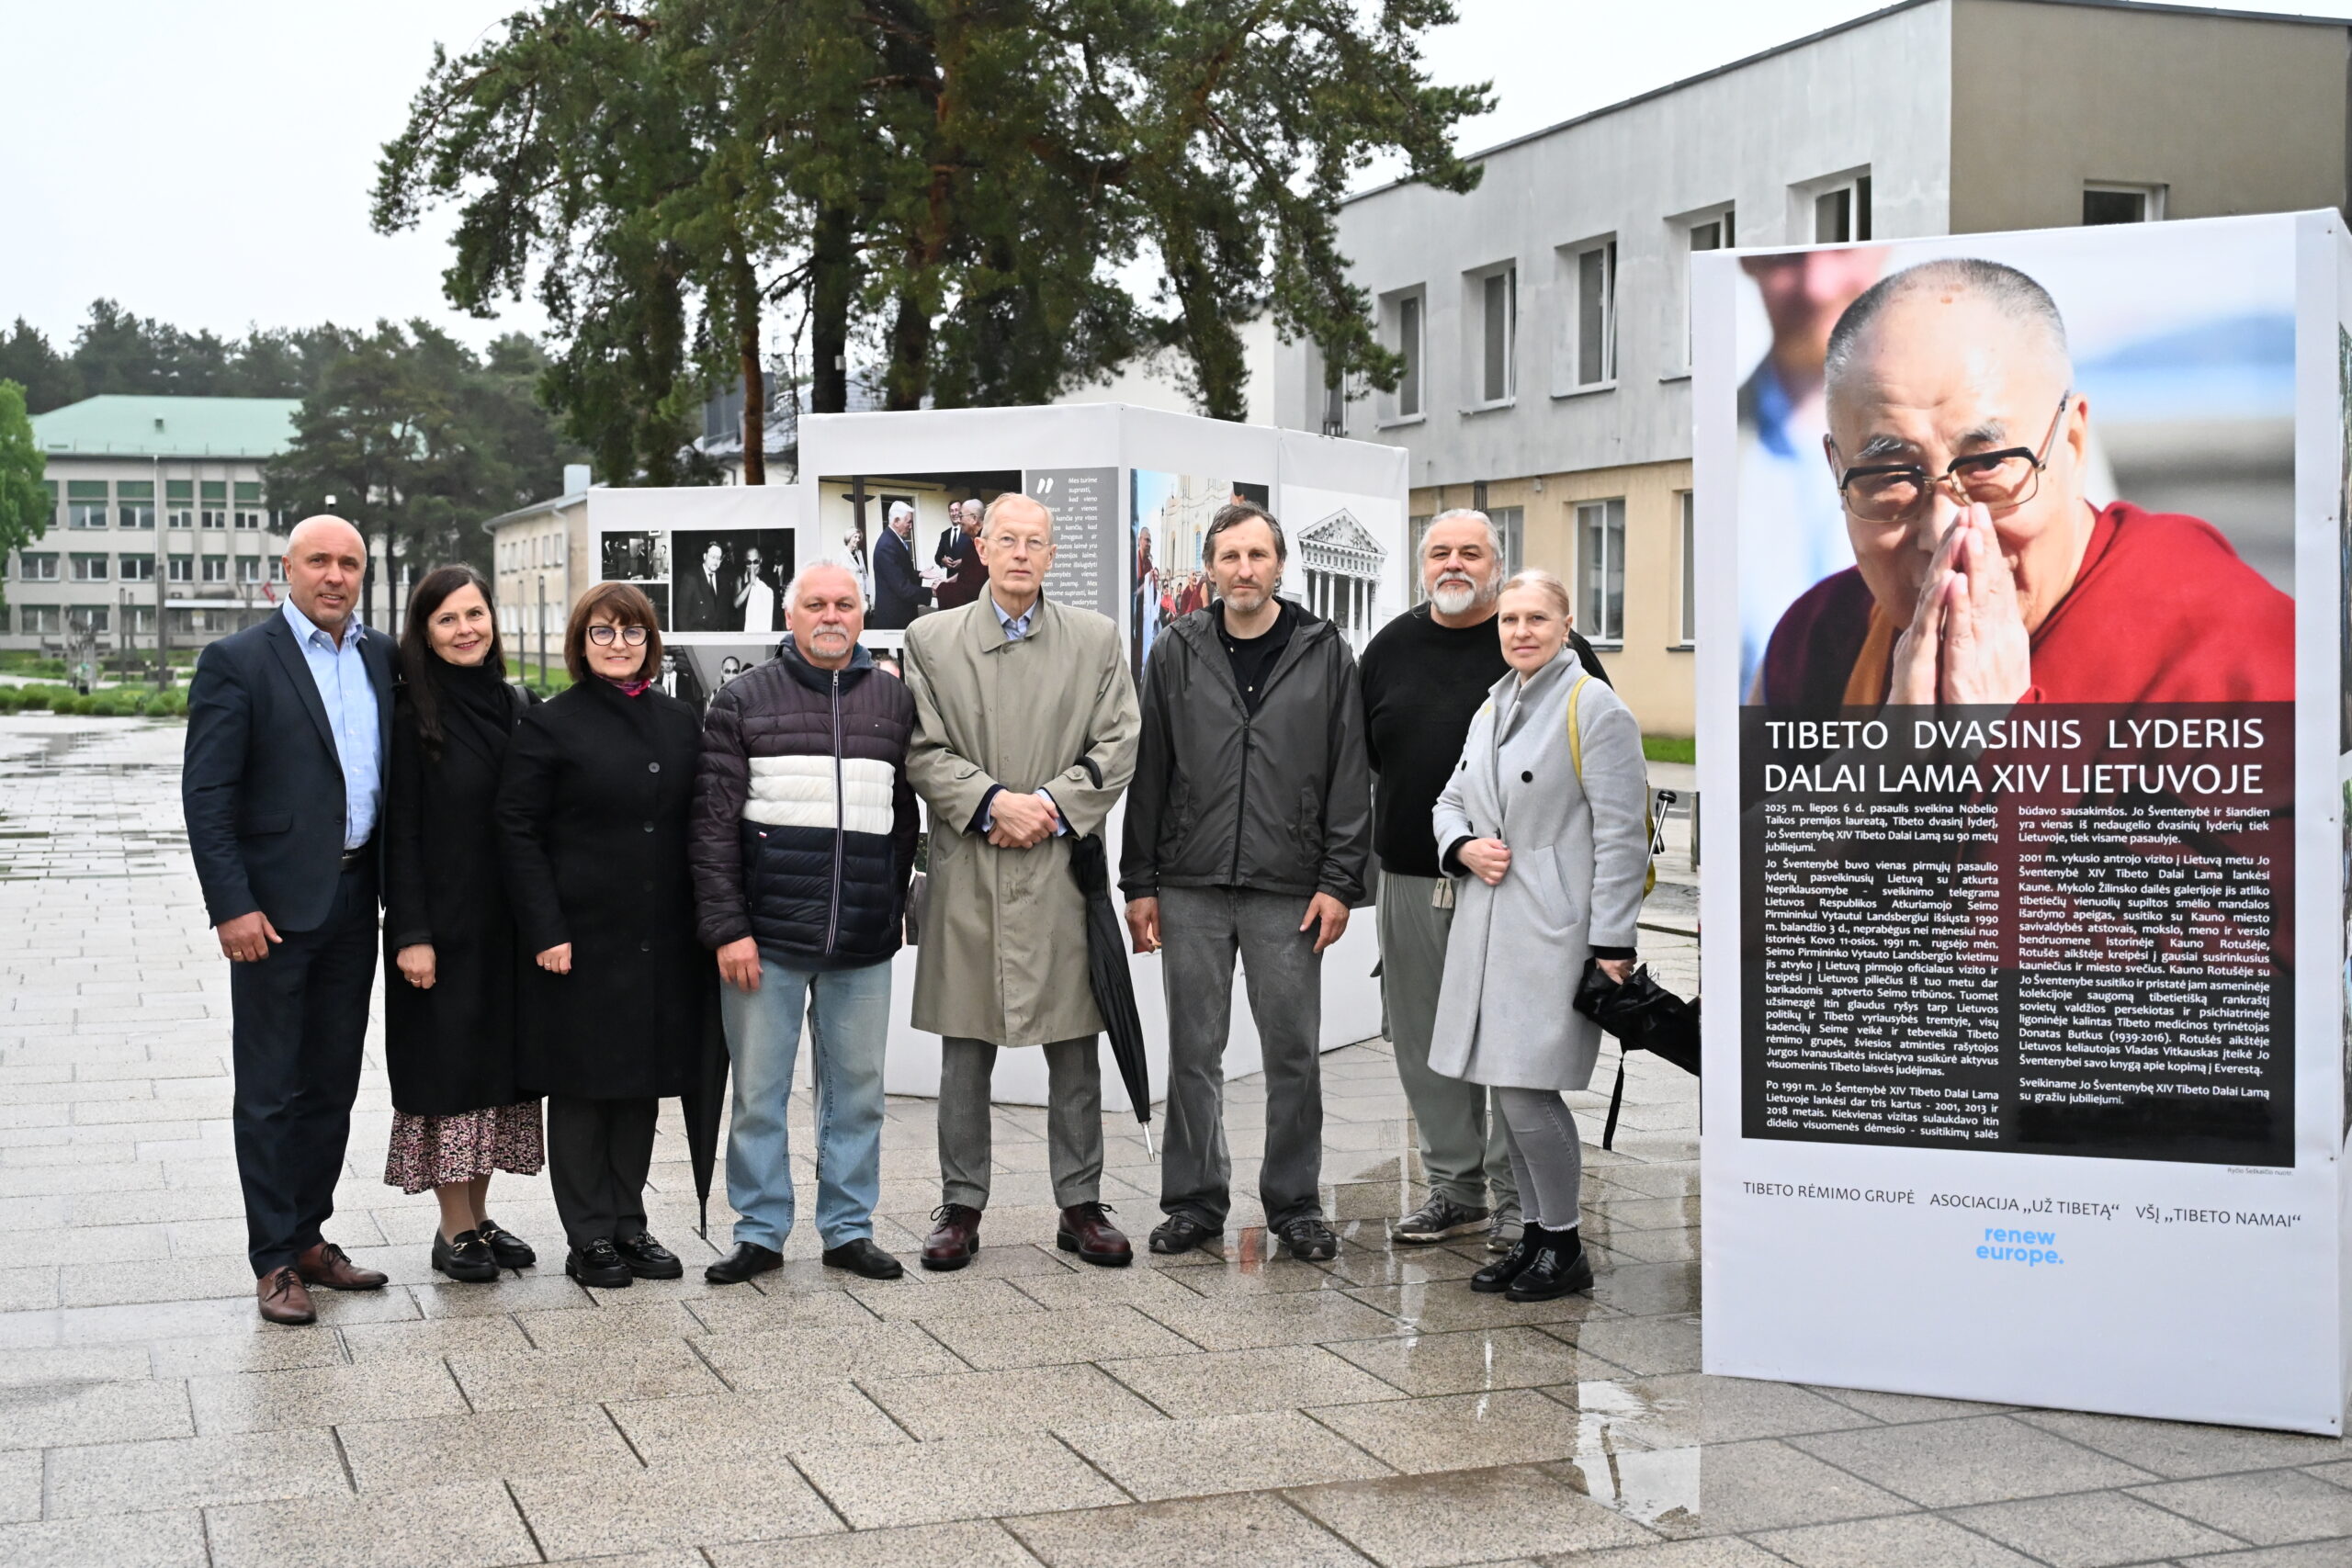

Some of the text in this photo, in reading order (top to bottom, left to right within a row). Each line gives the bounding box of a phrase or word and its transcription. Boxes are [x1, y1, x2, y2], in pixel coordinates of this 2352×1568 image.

[1765, 718, 2264, 750] TIBETO DVASINIS LYDERIS
[1765, 764, 2264, 794] DALAI LAMA XIV LIETUVOJE
[1765, 804, 1787, 814] 2025
[1809, 802, 1838, 814] liepos
[1855, 803, 1865, 812] d.
[1870, 803, 1908, 815] pasaulis
[1914, 803, 1953, 813] sveikina
[1959, 804, 1998, 813] Nobelio
[1765, 815, 1998, 829] Taikos premijos laureatą, Tibeto dvasinį lyderį,
[1765, 828, 1998, 843] Jo Šventenybę XIV Tibeto Dalai Lamą su 90 metų
[1765, 841, 1815, 853] jubiliejumi.
[1765, 857, 1998, 873] Jo Šventenybė buvo vienas pirmųjų pasaulio
[1765, 871, 1797, 884] lyderių
[1810, 873, 1873, 885] pasveikinusių
[1887, 874, 1923, 886] Lietuvą
[1962, 874, 1998, 885] atkurta
[1766, 884, 1848, 897] Nepriklausomybe
[1882, 886, 1934, 897] sveikinimo
[1949, 887, 1999, 899] telegrama
[1765, 897, 1998, 911] Lietuvos Respublikos Atkuriamojo Seimo
[1765, 908, 1998, 925] Pirmininkui Vytautui Landsbergiui išsiųsta 1990
[2019, 973, 2270, 993] Jo Šventenybe susitiko ir pristatė jam asmeninėje
[2018, 987, 2269, 1008] kolekcijoje saugomą tibetietišką rankraštį
[2018, 1001, 2269, 1021] sovietų valdžios persekiotas ir psichiatrinėje
[2018, 1013, 2269, 1033] ligoninėje kalintas Tibeto medicinos tyrinėtojas
[2018, 1027, 2269, 1048] Donatas Butkus (1939-2016). Rotušės aikštėje
[2018, 1041, 2269, 1060] Lietuvos keliautojas Vladas Vitkauskas įteikė Jo
[2018, 1053, 2081, 1068] Šventenybei
[2084, 1059, 2108, 1067] savo
[2109, 1058, 2141, 1072] knygą
[2143, 1060, 2165, 1072] apie
[2167, 1061, 2206, 1075] kopimą
[2214, 1063, 2263, 1077] Everestą.
[2019, 1077, 2269, 1100] Sveikiname Jo Šventenybę XIV Tibeto Dalai Lamą
[2019, 1091, 2123, 1105] su gražiu jubiliejumi.
[1743, 1181, 1793, 1197] TIBETO
[1798, 1183, 1860, 1201] RĖMIMO
[1865, 1189, 1915, 1204] GRUPĖ
[1929, 1193, 2019, 1211] ASOCIACIJA
[2135, 1204, 2160, 1224] VŠĮ
[1984, 1227, 2056, 1246] renew
[1975, 1244, 2064, 1267] europe.
